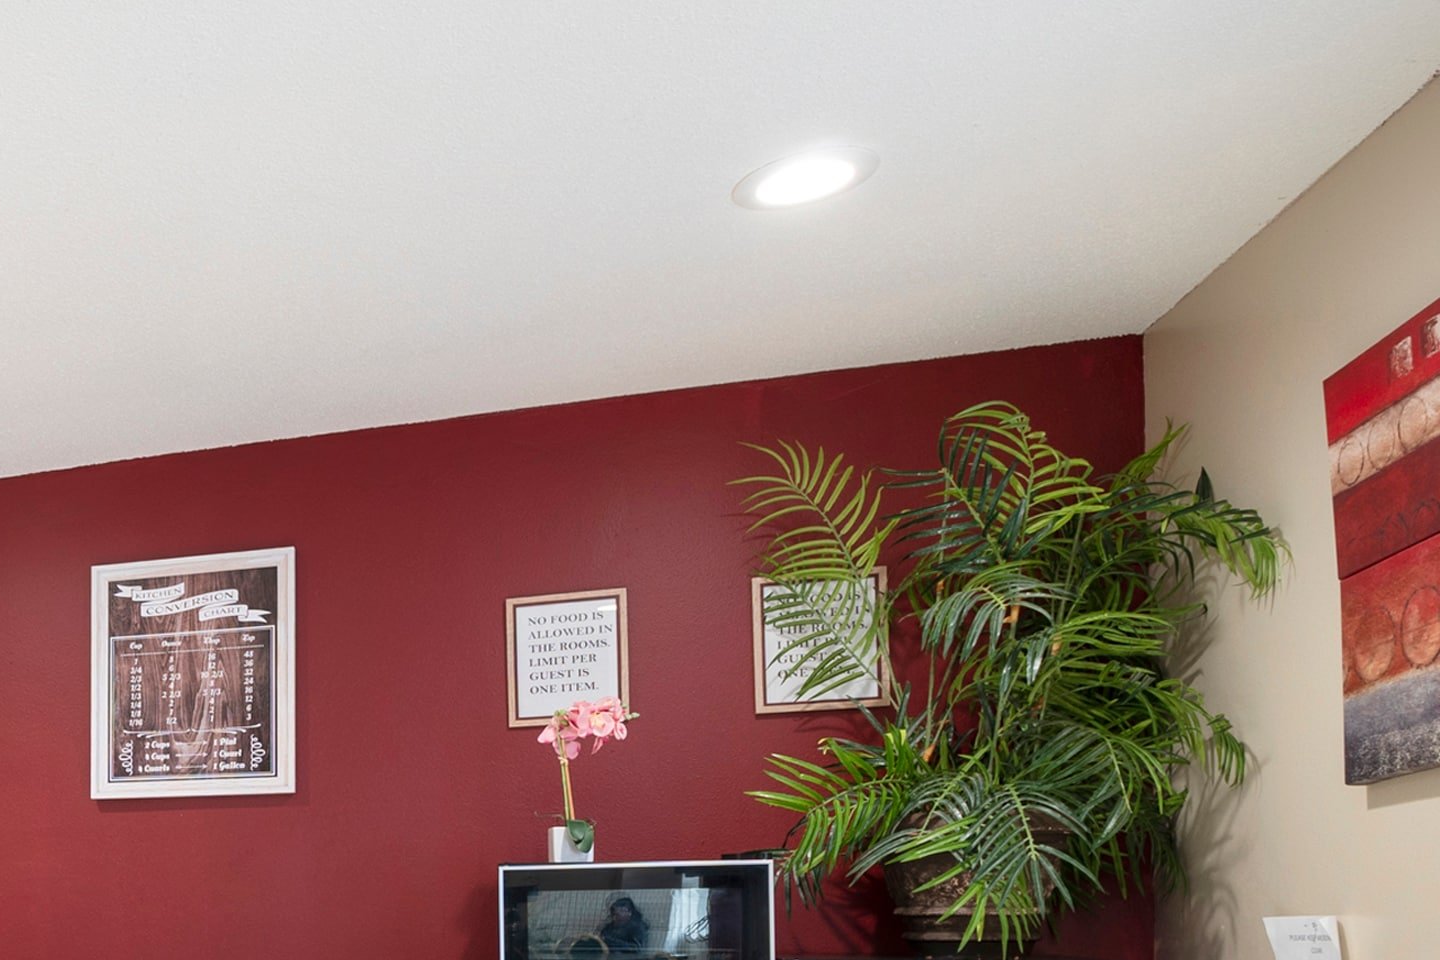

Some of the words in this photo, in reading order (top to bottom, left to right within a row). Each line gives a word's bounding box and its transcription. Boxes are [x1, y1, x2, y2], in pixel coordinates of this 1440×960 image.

[135, 588, 182, 600] KITCHEN
[145, 591, 234, 615] CONVERSION
[203, 606, 242, 618] CHART
[528, 617, 547, 626] NO
[550, 613, 588, 624] FOOD
[592, 611, 604, 621] IS
[528, 626, 595, 640] ALLOWED
[599, 624, 613, 634] IN
[129, 642, 143, 650] Cup
[529, 643, 556, 653] THE
[560, 639, 611, 651] ROOMS.
[529, 656, 568, 667] LIMIT
[572, 653, 597, 664] PER
[529, 669, 573, 681] GUEST
[578, 668, 590, 678] IS
[530, 684, 557, 695] ONE
[561, 681, 599, 693] ITEM.
[151, 741, 170, 750] Cups
[219, 737, 236, 746] Pint
[151, 752, 170, 762] Cups
[219, 749, 242, 759] Quart
[144, 764, 170, 773] Quarts
[219, 761, 245, 771] Gallon
